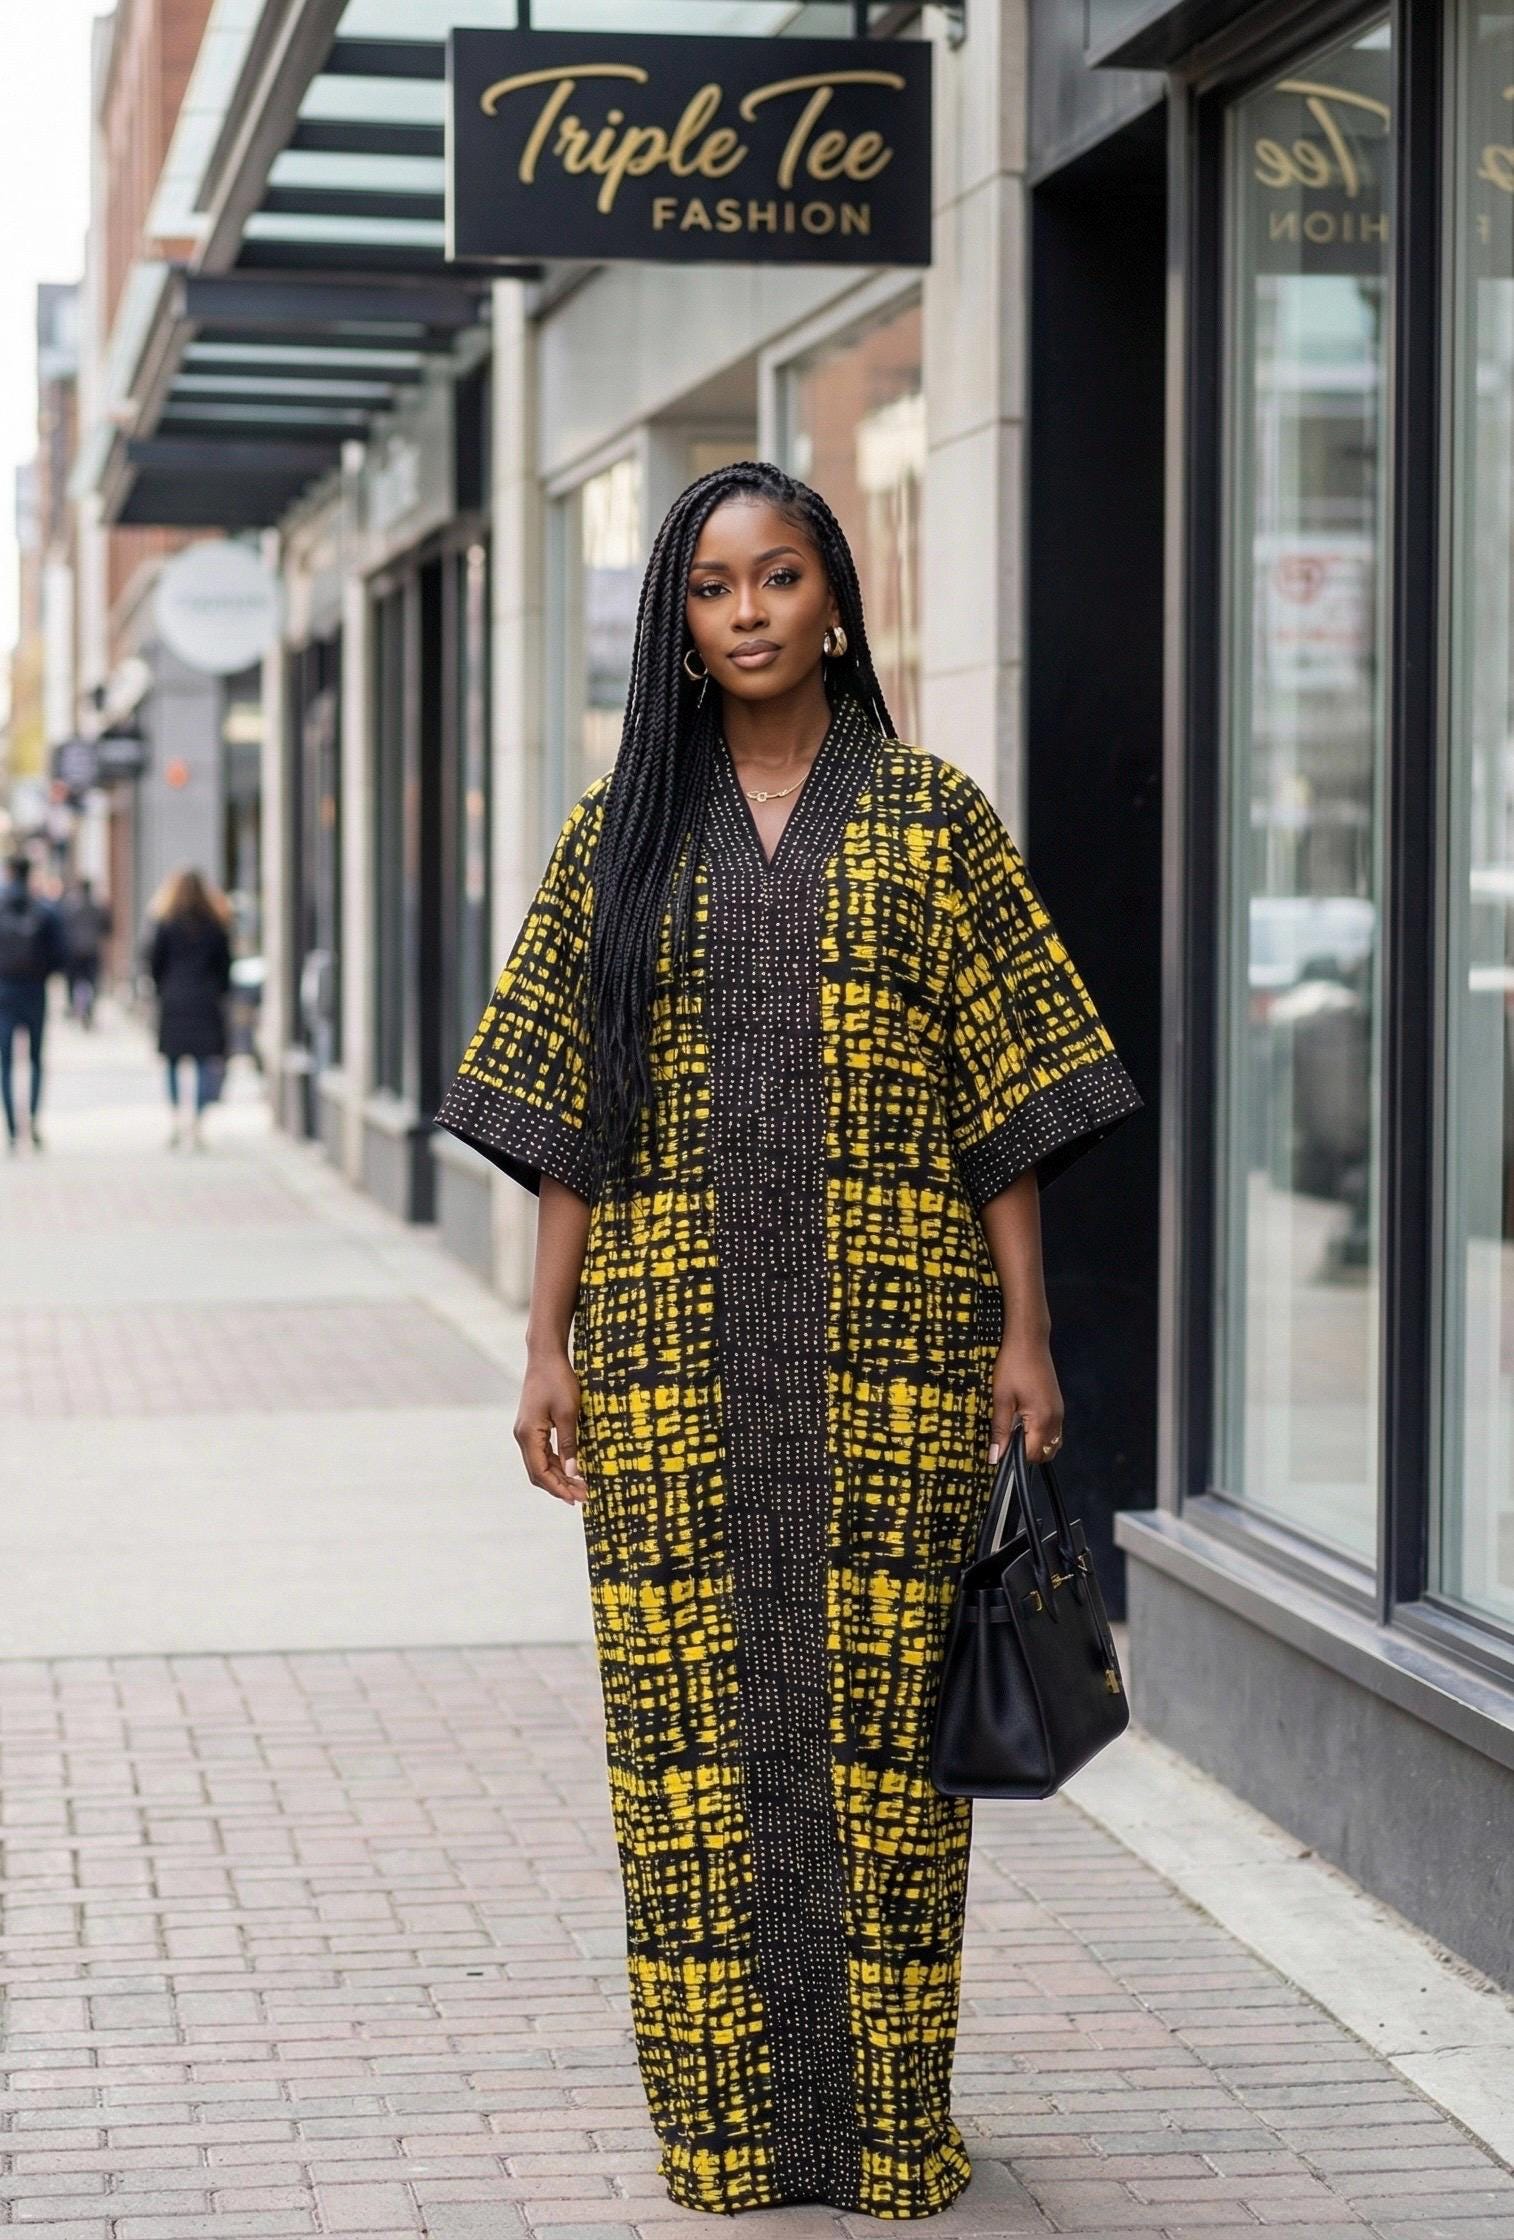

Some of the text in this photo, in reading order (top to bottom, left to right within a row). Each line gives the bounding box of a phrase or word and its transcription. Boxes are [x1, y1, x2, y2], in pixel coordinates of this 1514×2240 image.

[481, 63, 905, 214] Triple Tee
[652, 198, 871, 234] FASHION
